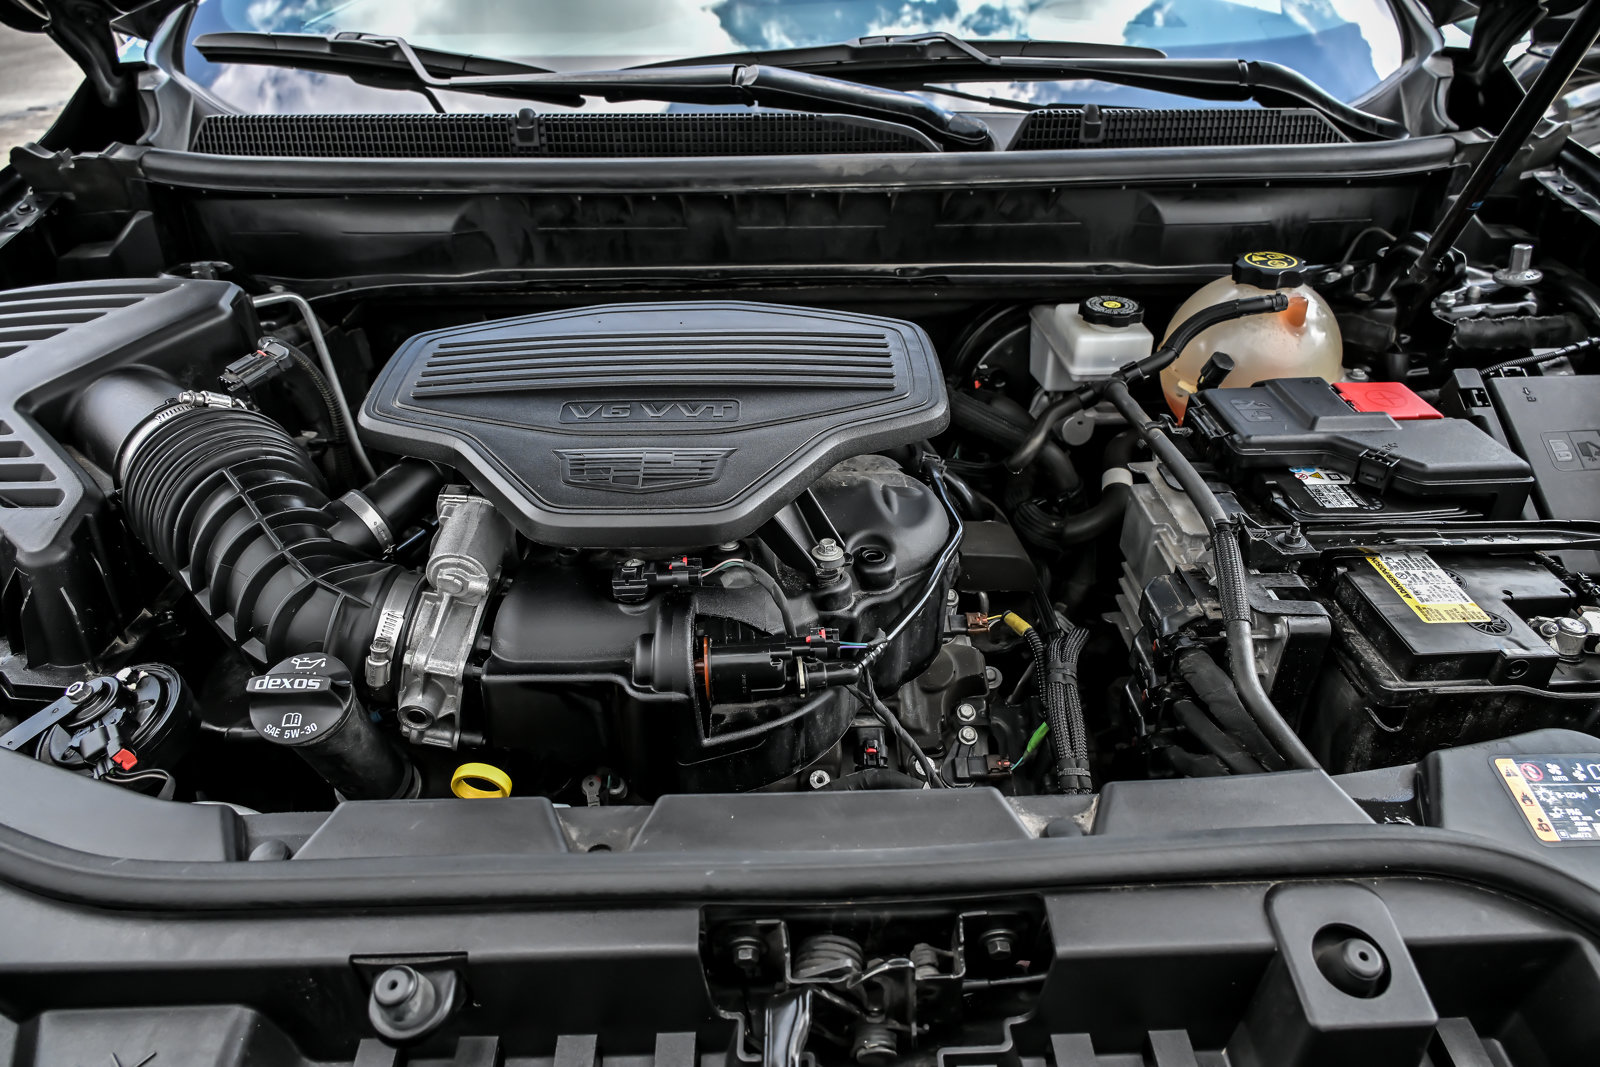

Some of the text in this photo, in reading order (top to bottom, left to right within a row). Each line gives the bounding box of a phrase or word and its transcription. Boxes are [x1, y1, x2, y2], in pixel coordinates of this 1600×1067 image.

[569, 403, 733, 419] V6 VVT
[254, 676, 321, 690] dexos
[264, 722, 318, 739] SAE 5W-30
